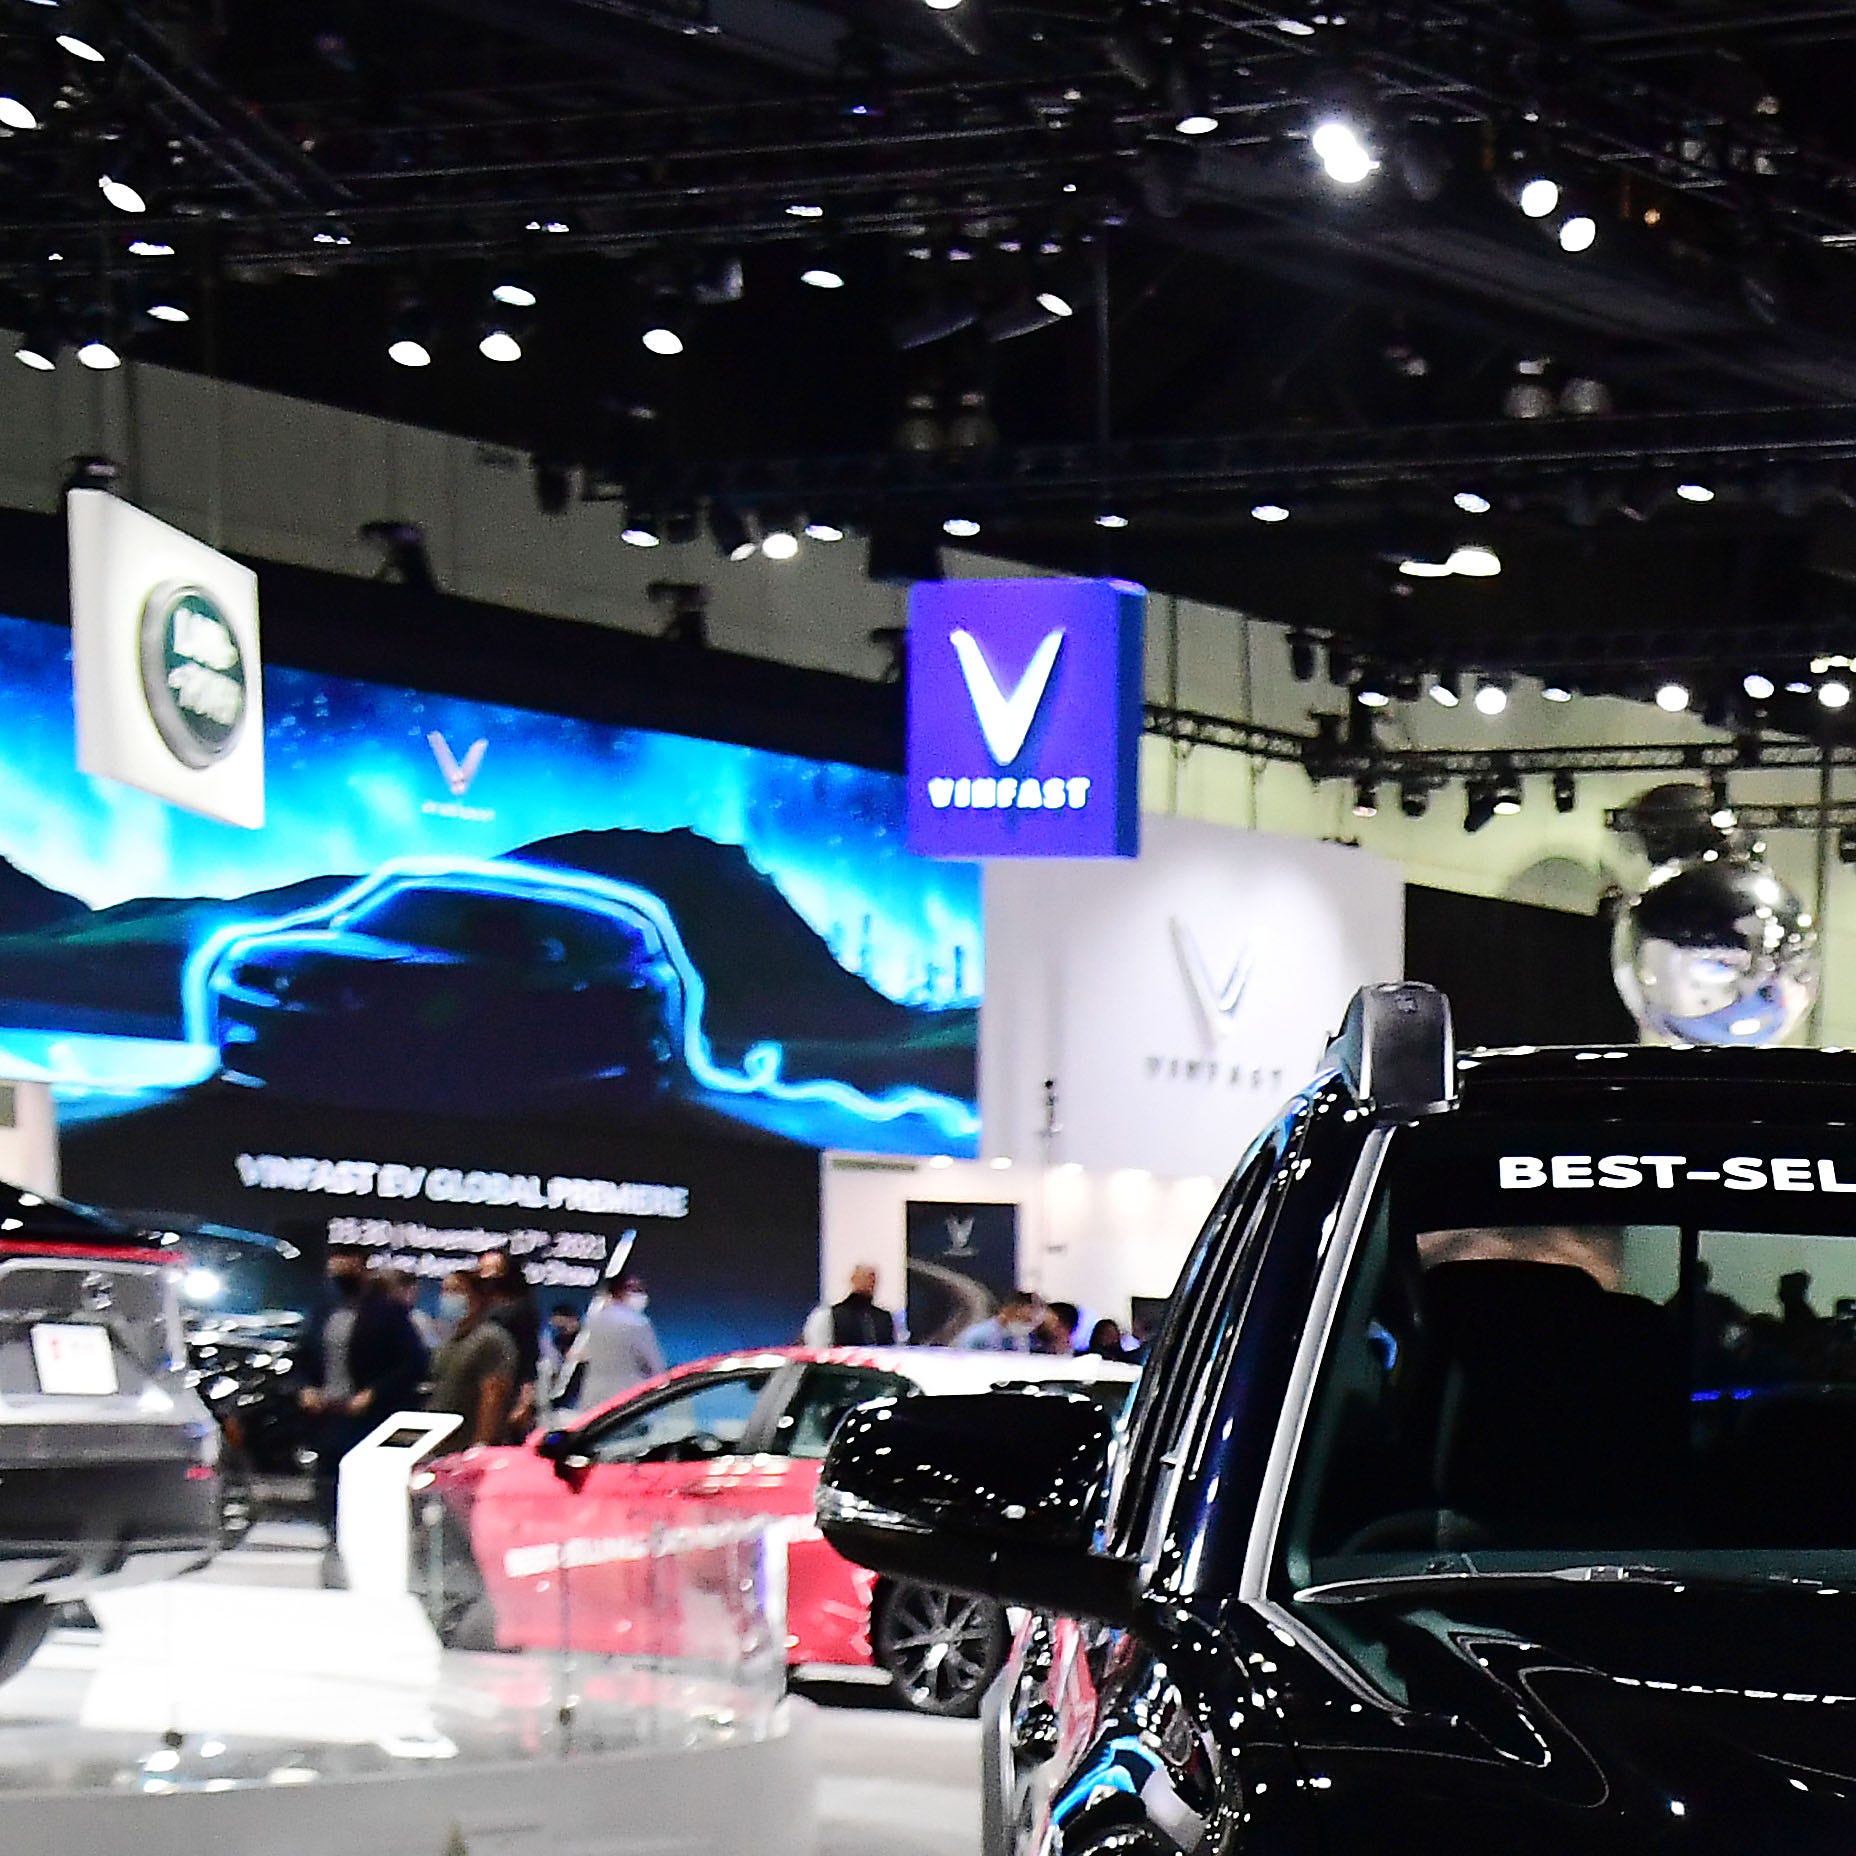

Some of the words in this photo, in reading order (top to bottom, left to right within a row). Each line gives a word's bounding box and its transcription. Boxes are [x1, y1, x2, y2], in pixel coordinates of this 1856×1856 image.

[928, 776, 1091, 809] VINFAST
[234, 1152, 378, 1196] VINFAST
[425, 1167, 548, 1208] GLOBAL
[547, 1175, 690, 1218] PREMIERE
